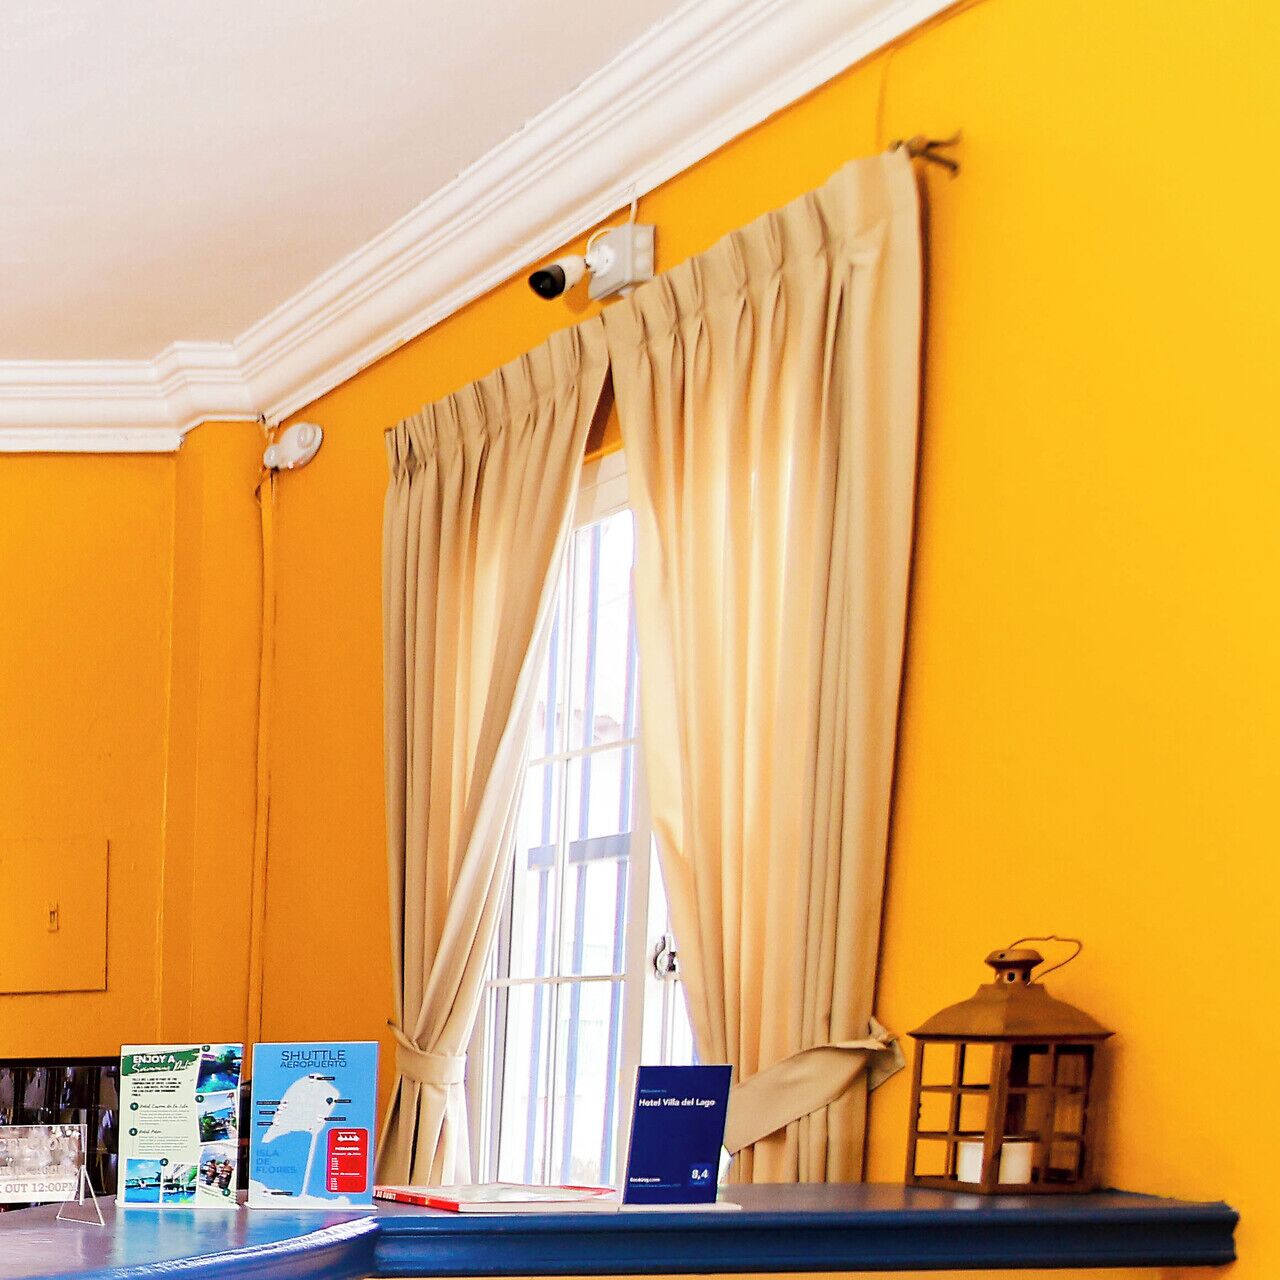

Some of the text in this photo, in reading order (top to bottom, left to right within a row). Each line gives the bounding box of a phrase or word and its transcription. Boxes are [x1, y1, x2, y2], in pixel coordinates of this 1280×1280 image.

[132, 1055, 176, 1064] ENJOY A
[281, 1050, 346, 1061] SHUTTLE
[280, 1060, 347, 1069] AEROPUERTO
[639, 1098, 716, 1108] Hotel Villa del Lago
[256, 1149, 279, 1157] ISLA
[256, 1166, 297, 1174] FLORES
[4, 1183, 28, 1193] OUT
